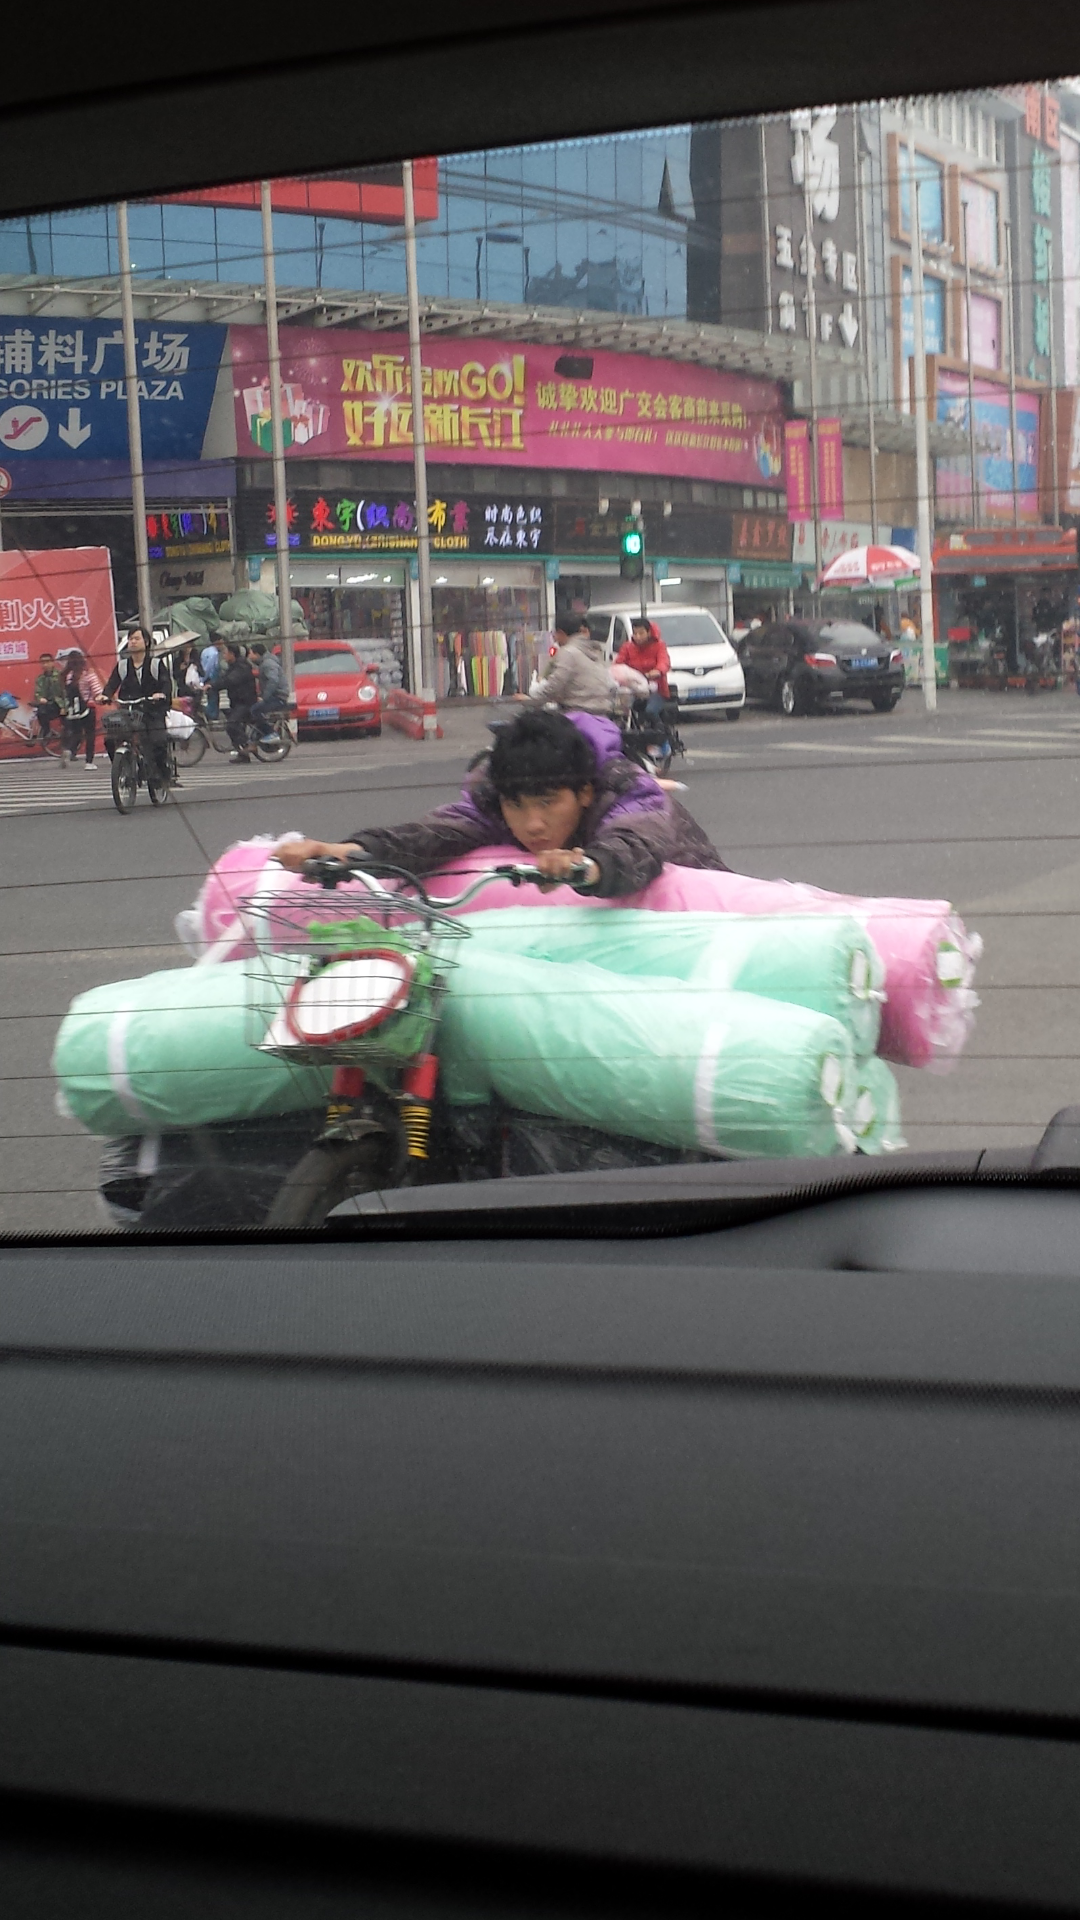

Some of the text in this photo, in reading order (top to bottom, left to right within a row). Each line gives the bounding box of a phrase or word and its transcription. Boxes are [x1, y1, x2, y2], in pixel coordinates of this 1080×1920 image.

[0, 328, 190, 375] 辅料广场
[100, 380, 184, 400] PLAZA
